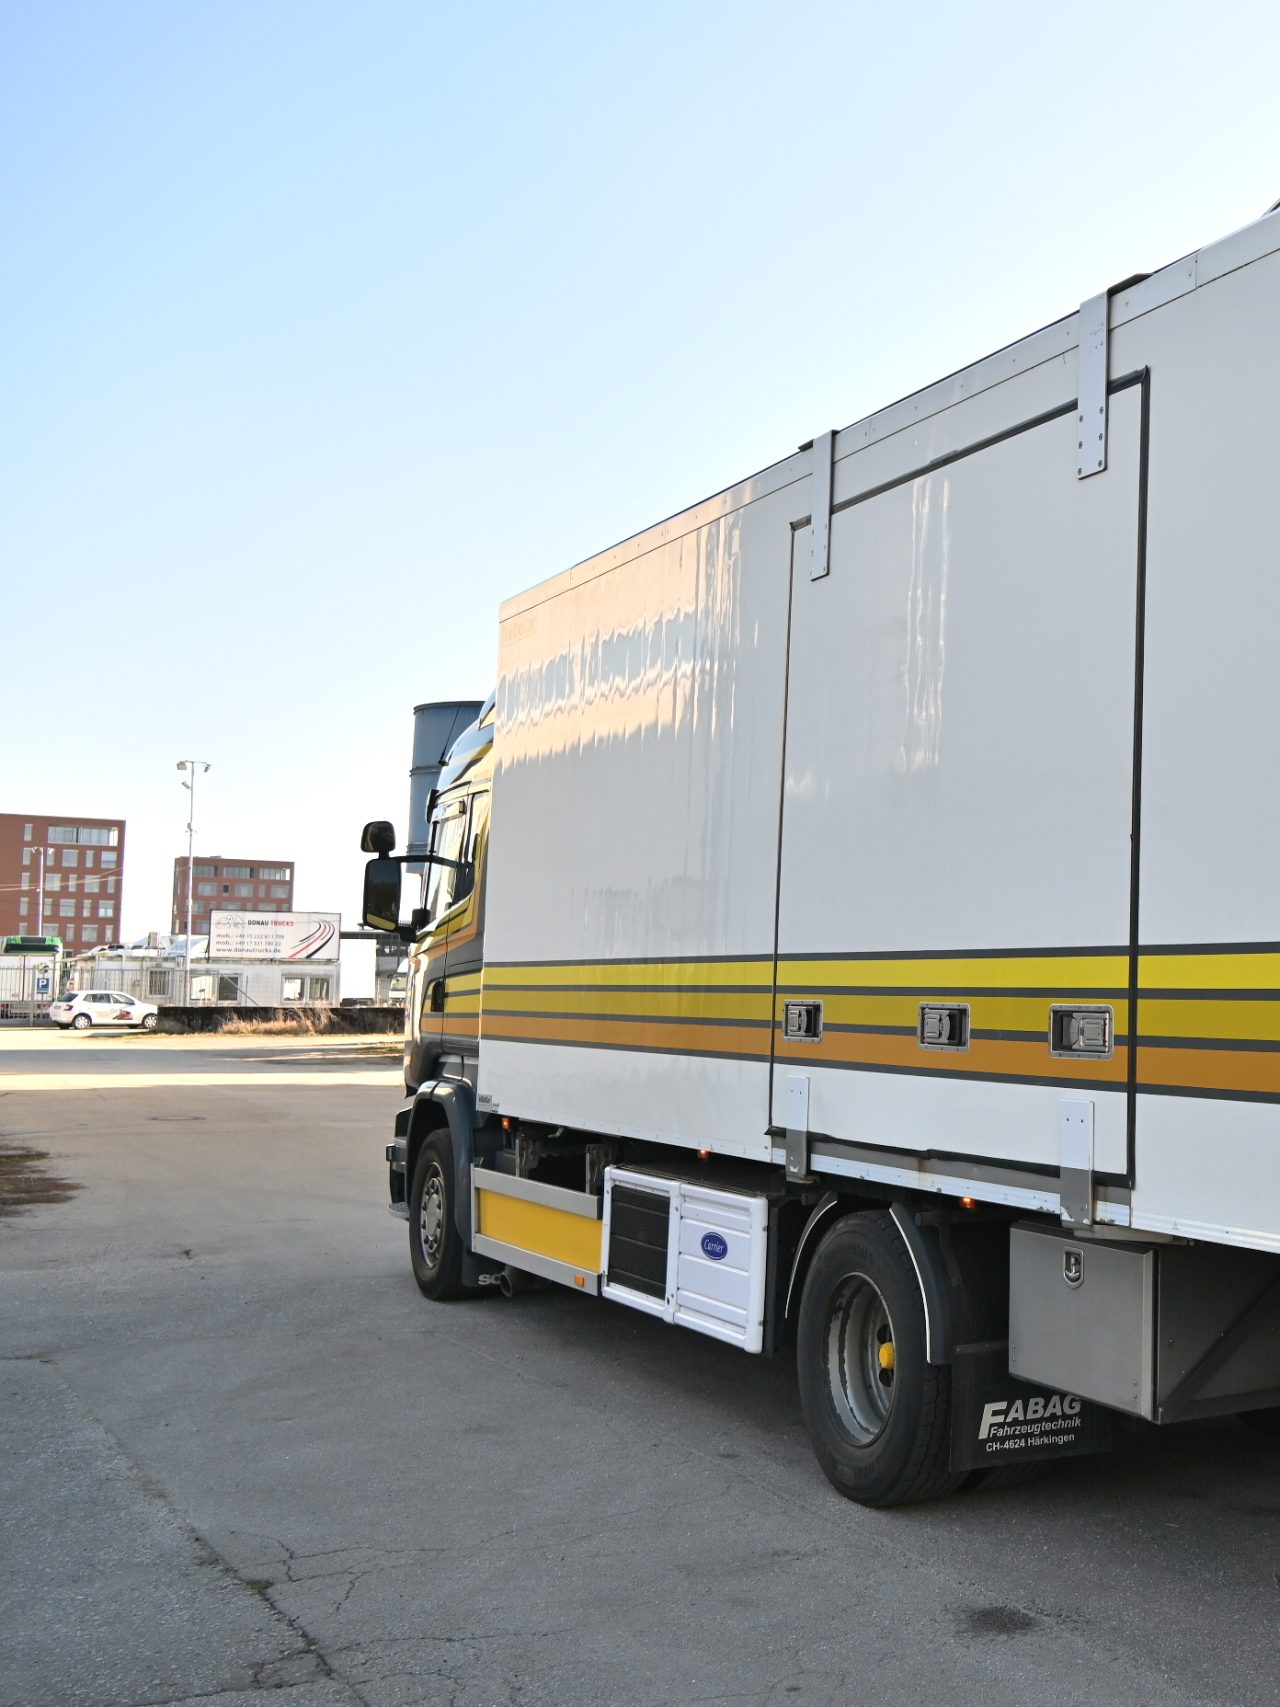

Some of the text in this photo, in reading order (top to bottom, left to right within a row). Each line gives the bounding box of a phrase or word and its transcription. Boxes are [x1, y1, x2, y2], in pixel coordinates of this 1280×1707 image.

[703, 1239, 724, 1253] Carrier
[978, 1394, 1082, 1440] FABAG
[990, 1416, 1082, 1438] Fahrzeugtechnik
[986, 1433, 1075, 1452] CH-4624 Härkingen
